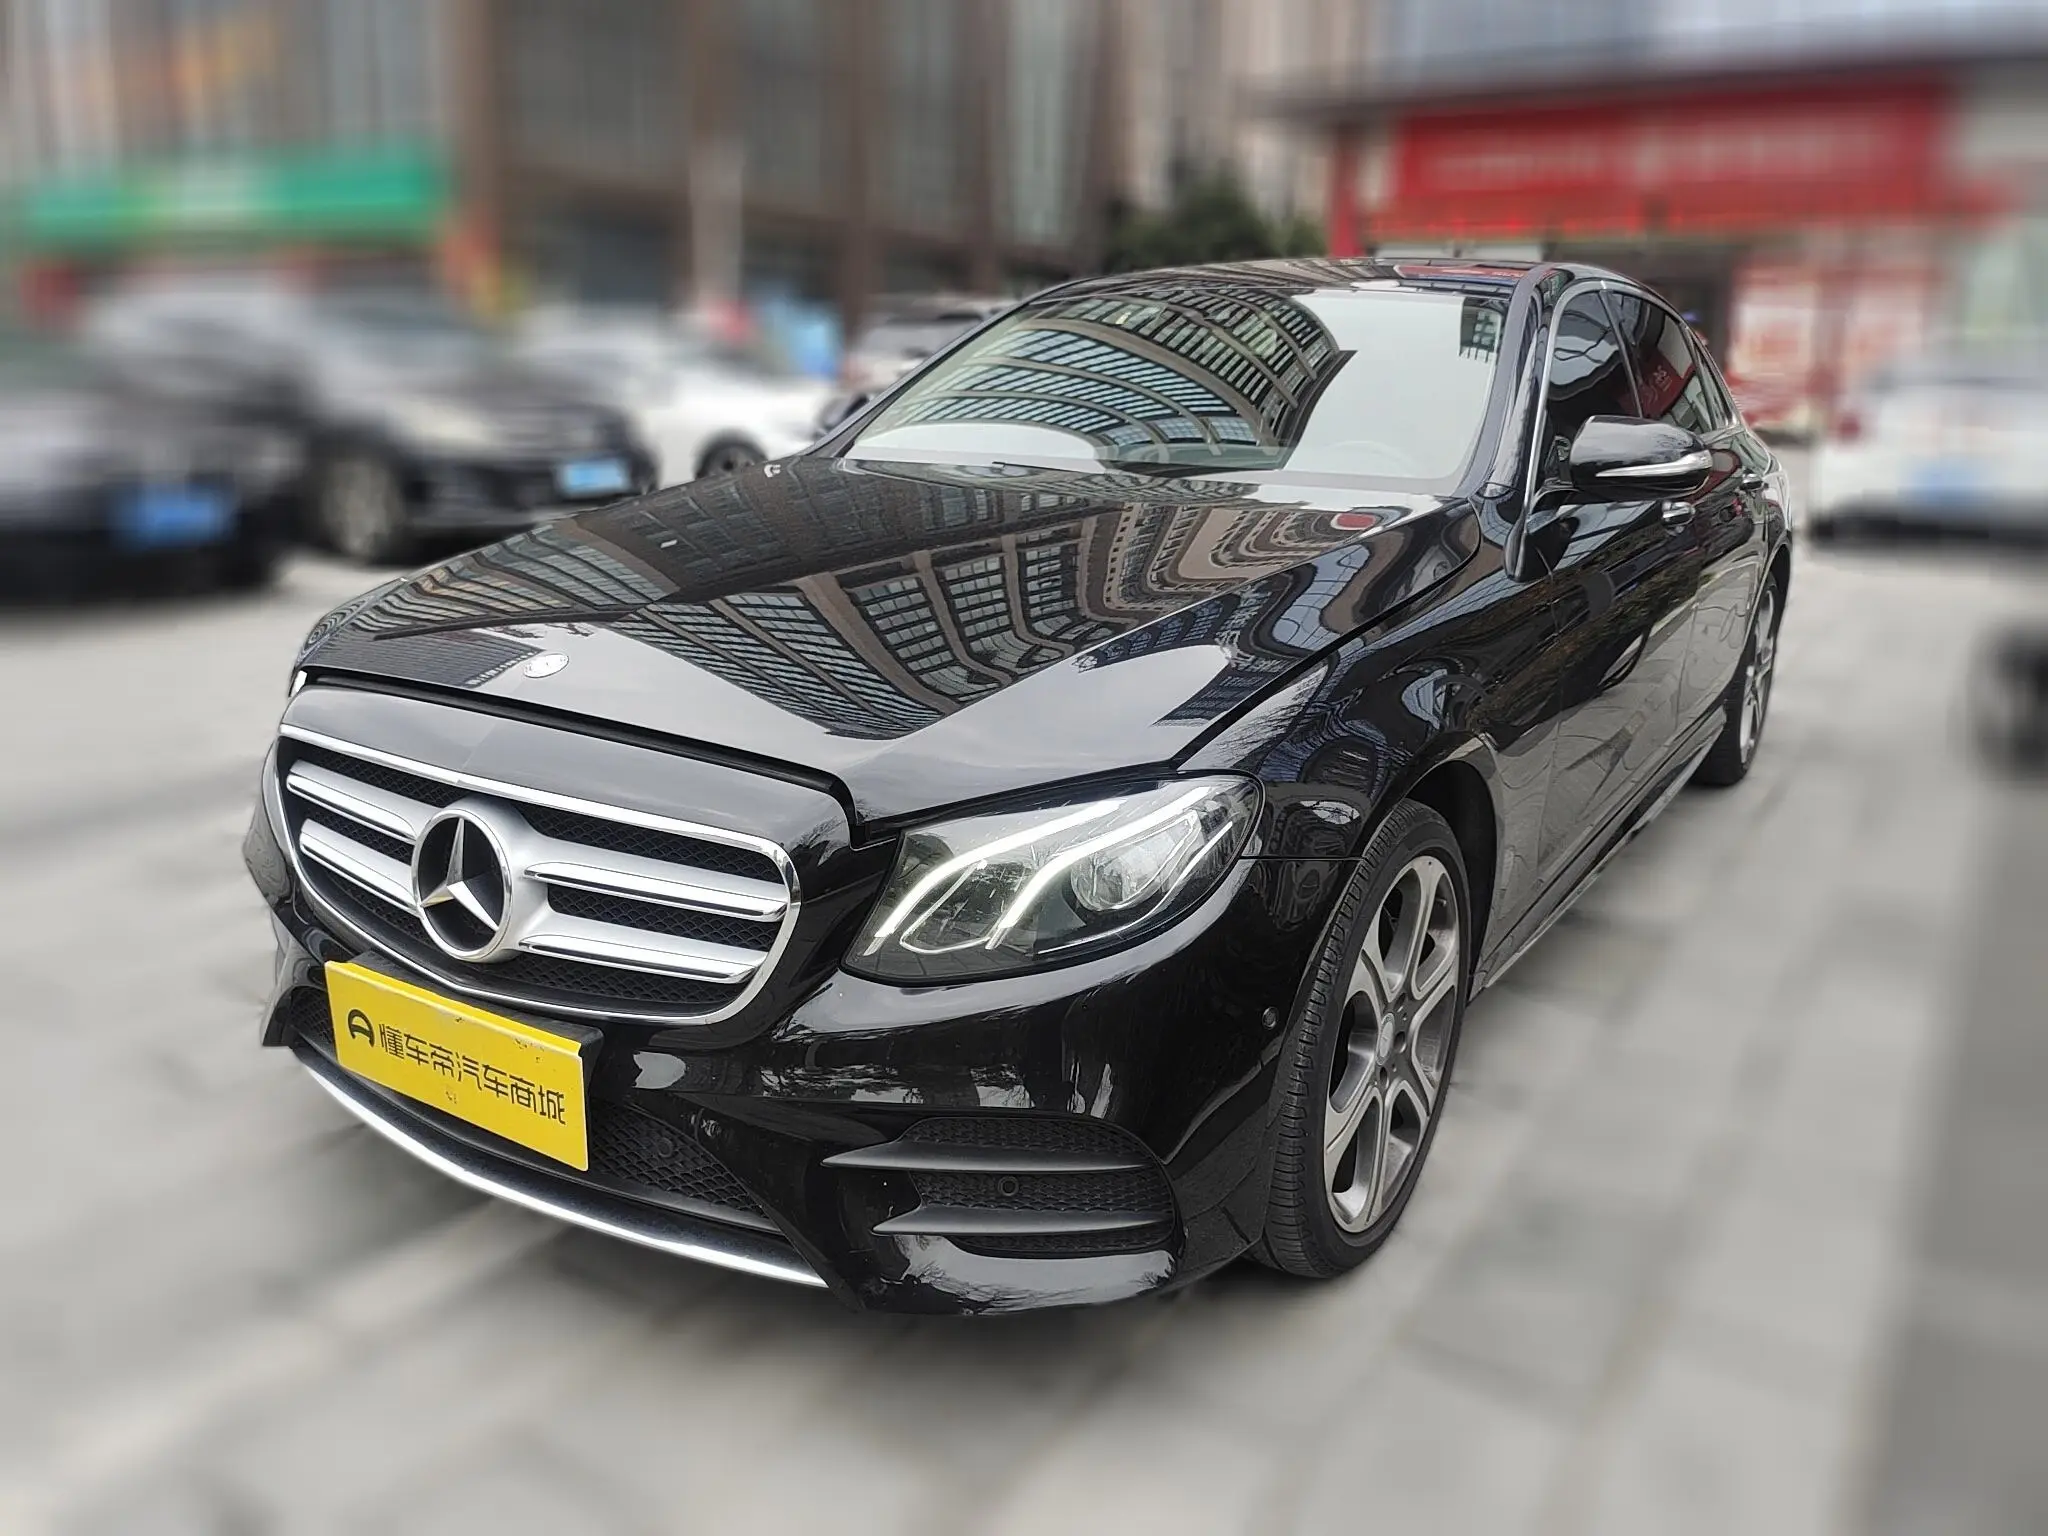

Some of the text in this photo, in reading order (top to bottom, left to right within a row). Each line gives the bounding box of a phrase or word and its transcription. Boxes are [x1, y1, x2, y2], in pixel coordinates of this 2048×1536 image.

[379, 1024, 566, 1125] 懂车帝汽车商城
